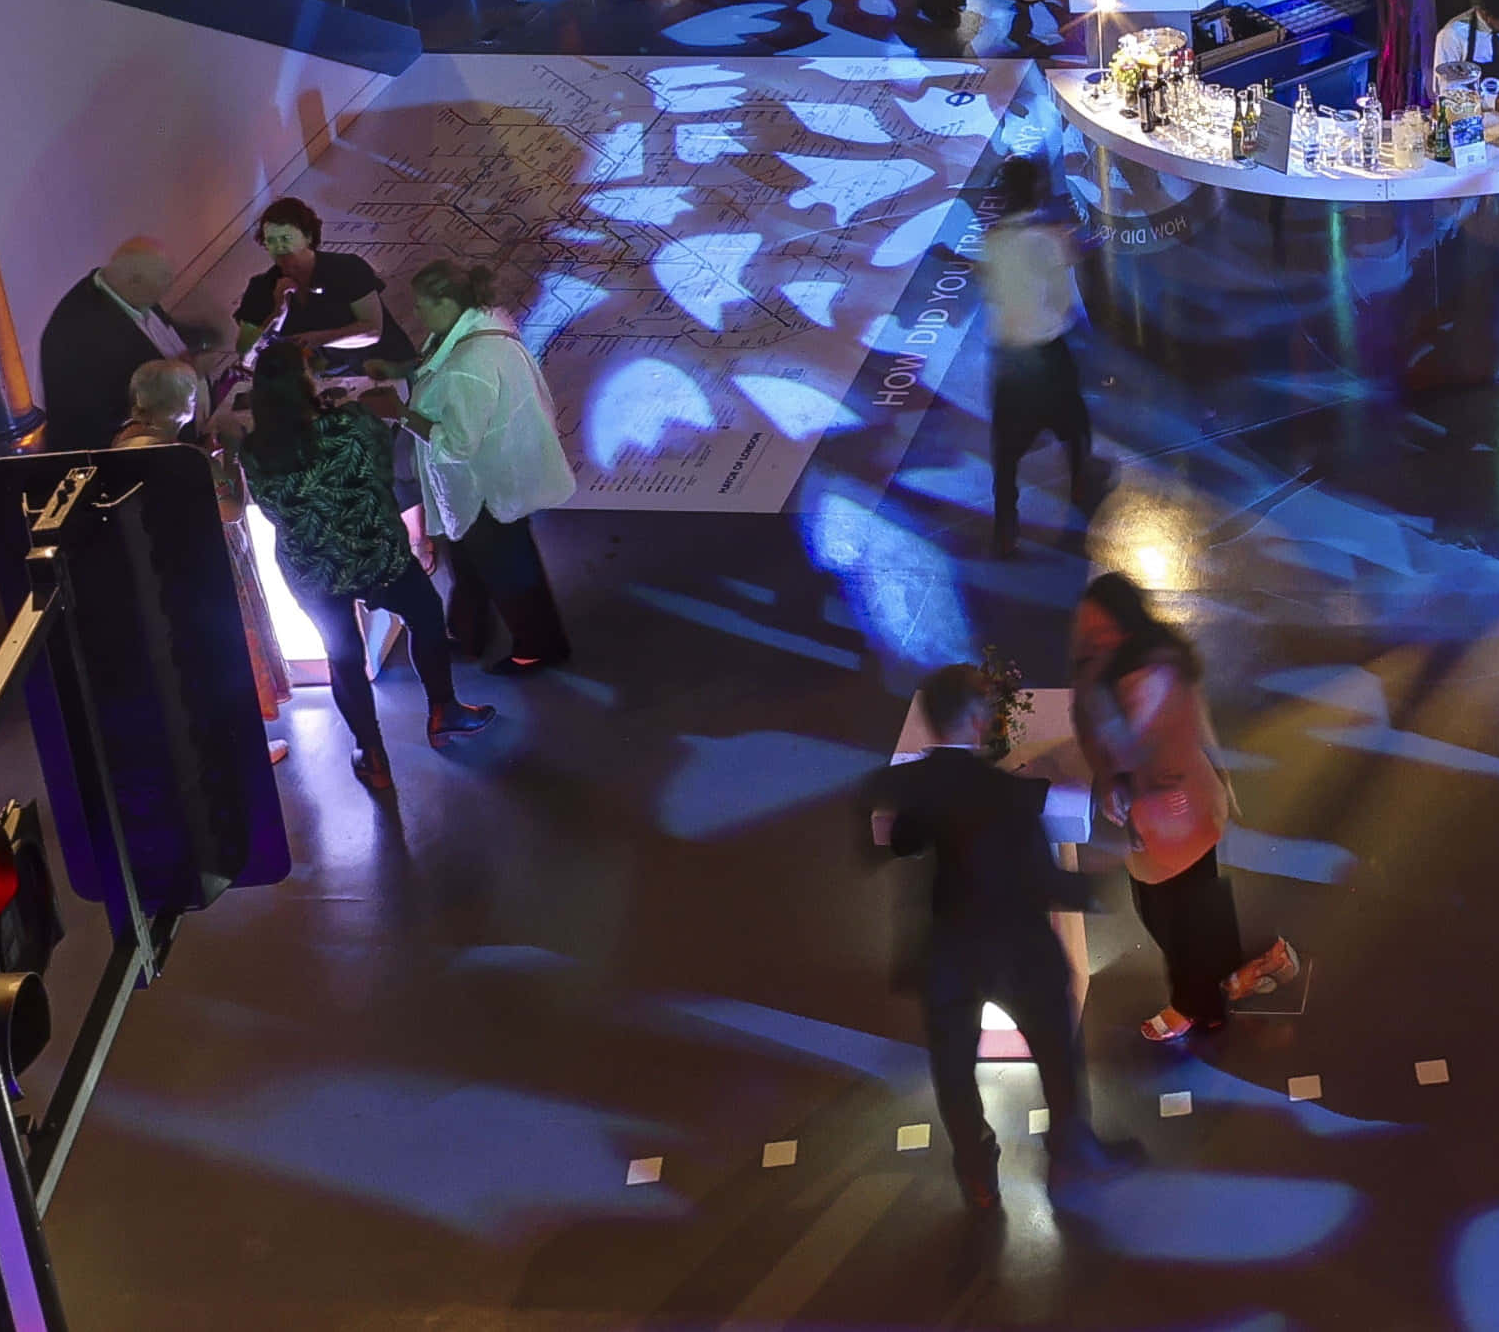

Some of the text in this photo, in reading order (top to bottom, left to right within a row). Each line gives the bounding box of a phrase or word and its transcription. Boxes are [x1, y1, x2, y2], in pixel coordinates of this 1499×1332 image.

[872, 350, 928, 406] HOW
[905, 308, 949, 344] DID
[927, 261, 975, 304] YOU
[739, 432, 764, 461] LONDON
